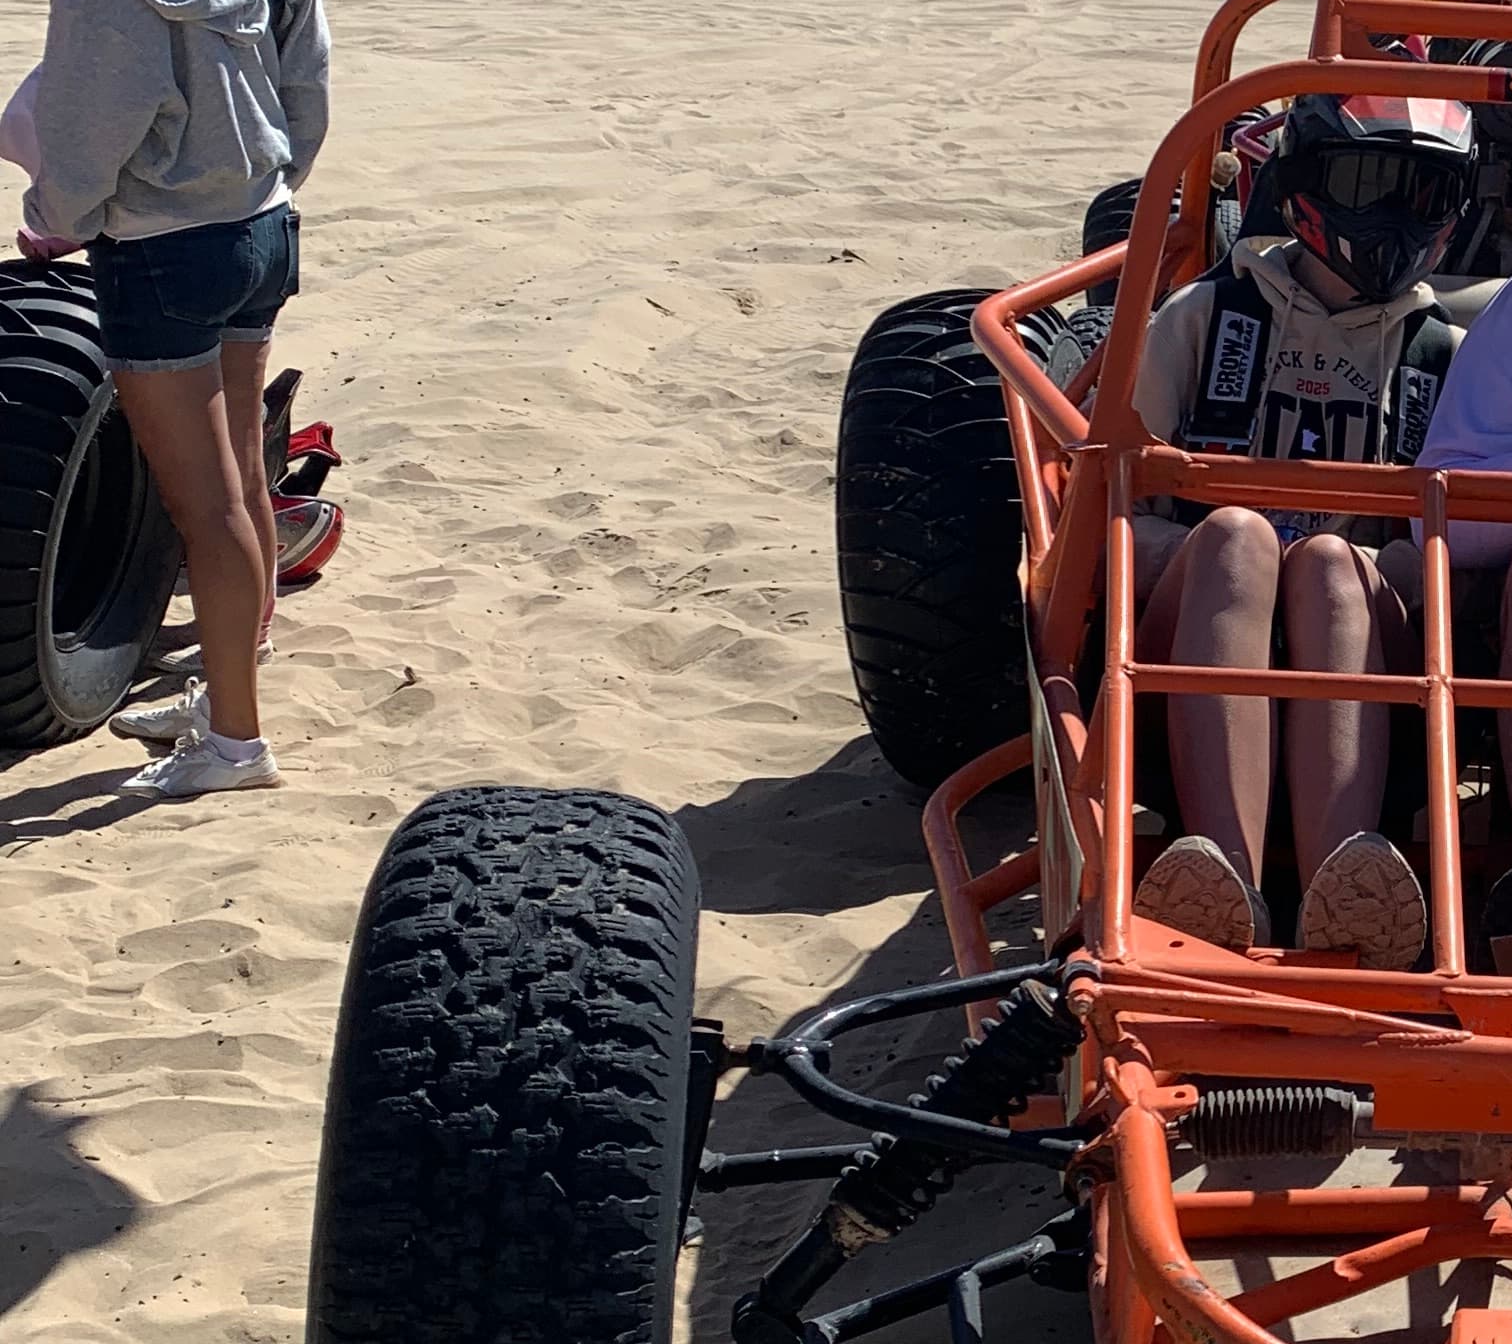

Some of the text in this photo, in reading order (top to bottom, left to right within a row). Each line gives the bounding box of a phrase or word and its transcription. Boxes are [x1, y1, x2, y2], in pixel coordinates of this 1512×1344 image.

[1214, 337, 1243, 396] CROW
[1233, 321, 1257, 398] SAFETY GEAR
[1296, 378, 1330, 395] 2025
[1402, 394, 1425, 455] CROW
